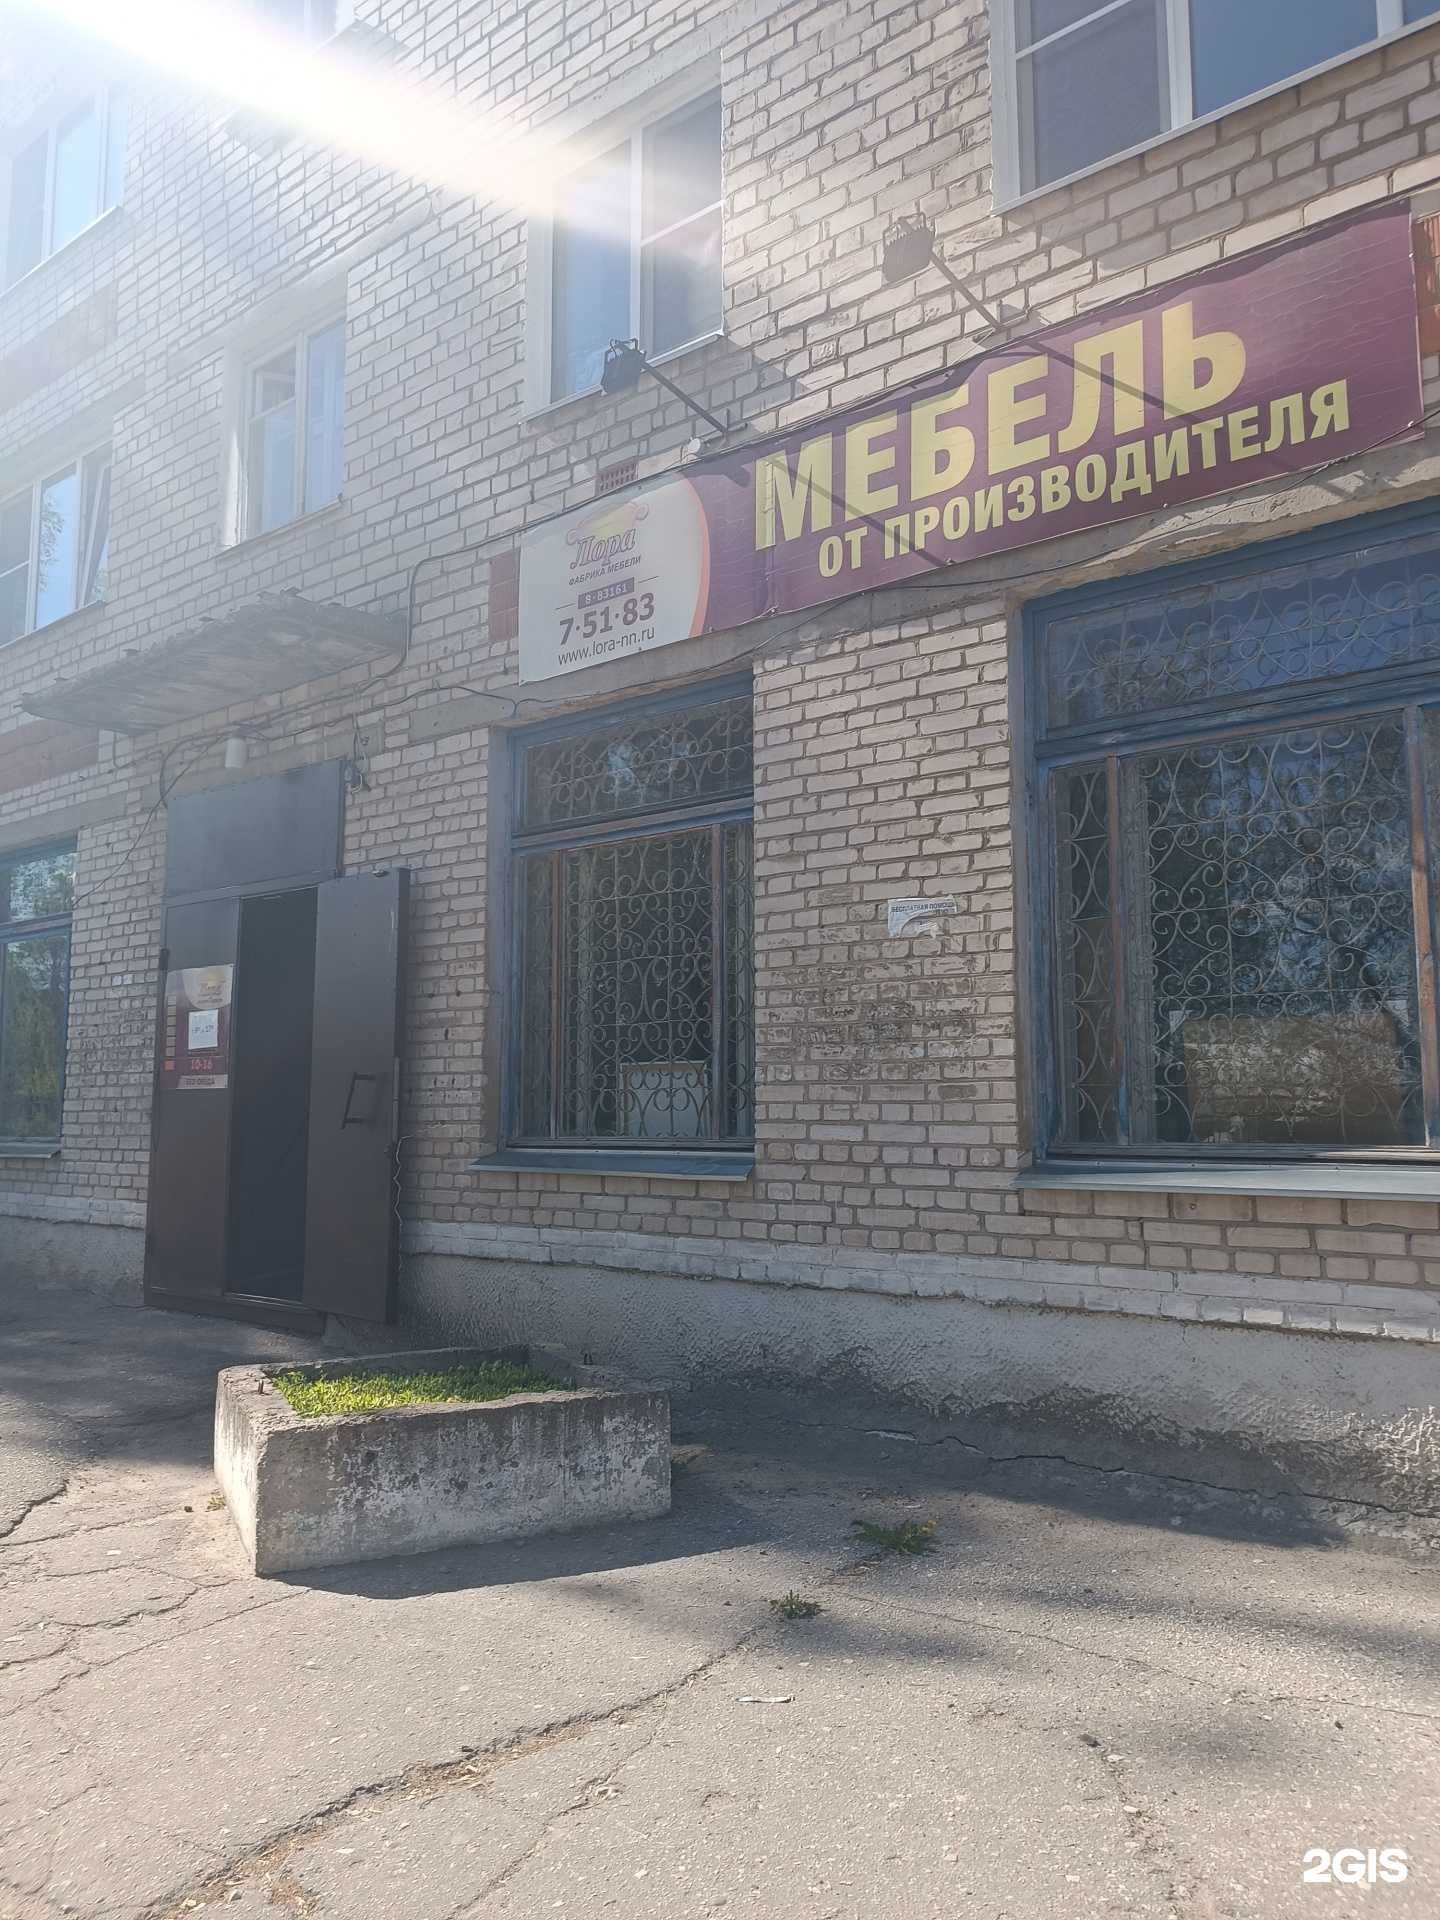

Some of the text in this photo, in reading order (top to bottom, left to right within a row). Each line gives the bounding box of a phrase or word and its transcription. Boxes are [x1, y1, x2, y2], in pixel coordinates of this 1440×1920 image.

[754, 300, 1247, 551] МЕБЕЛЬ
[818, 379, 1350, 578] ОТ ПРОИЗВОДИТЕЛЯ
[568, 555, 641, 586] ФАБРИКА МЕБЕЛИ
[557, 625, 656, 665] www.lora-nn.ru
